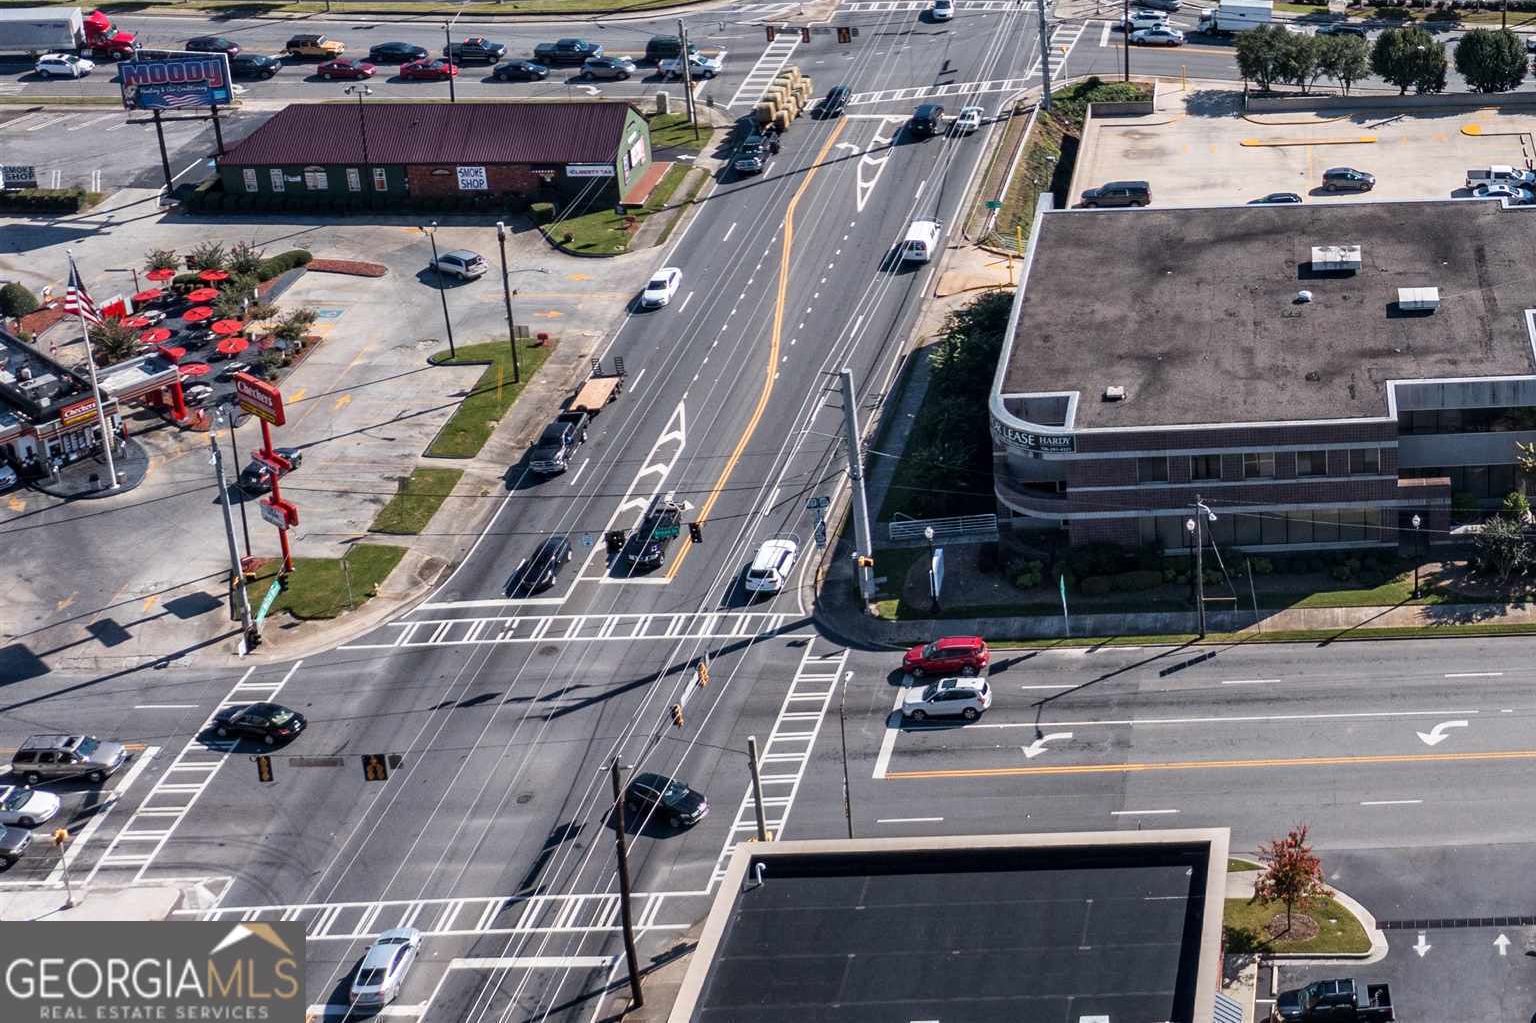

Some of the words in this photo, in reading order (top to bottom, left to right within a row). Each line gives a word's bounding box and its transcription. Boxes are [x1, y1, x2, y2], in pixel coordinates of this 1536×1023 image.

[459, 168, 484, 177] SMOKE
[461, 179, 485, 188] SHOP
[1003, 427, 1036, 446] LEASE
[1039, 437, 1071, 445] HARDY
